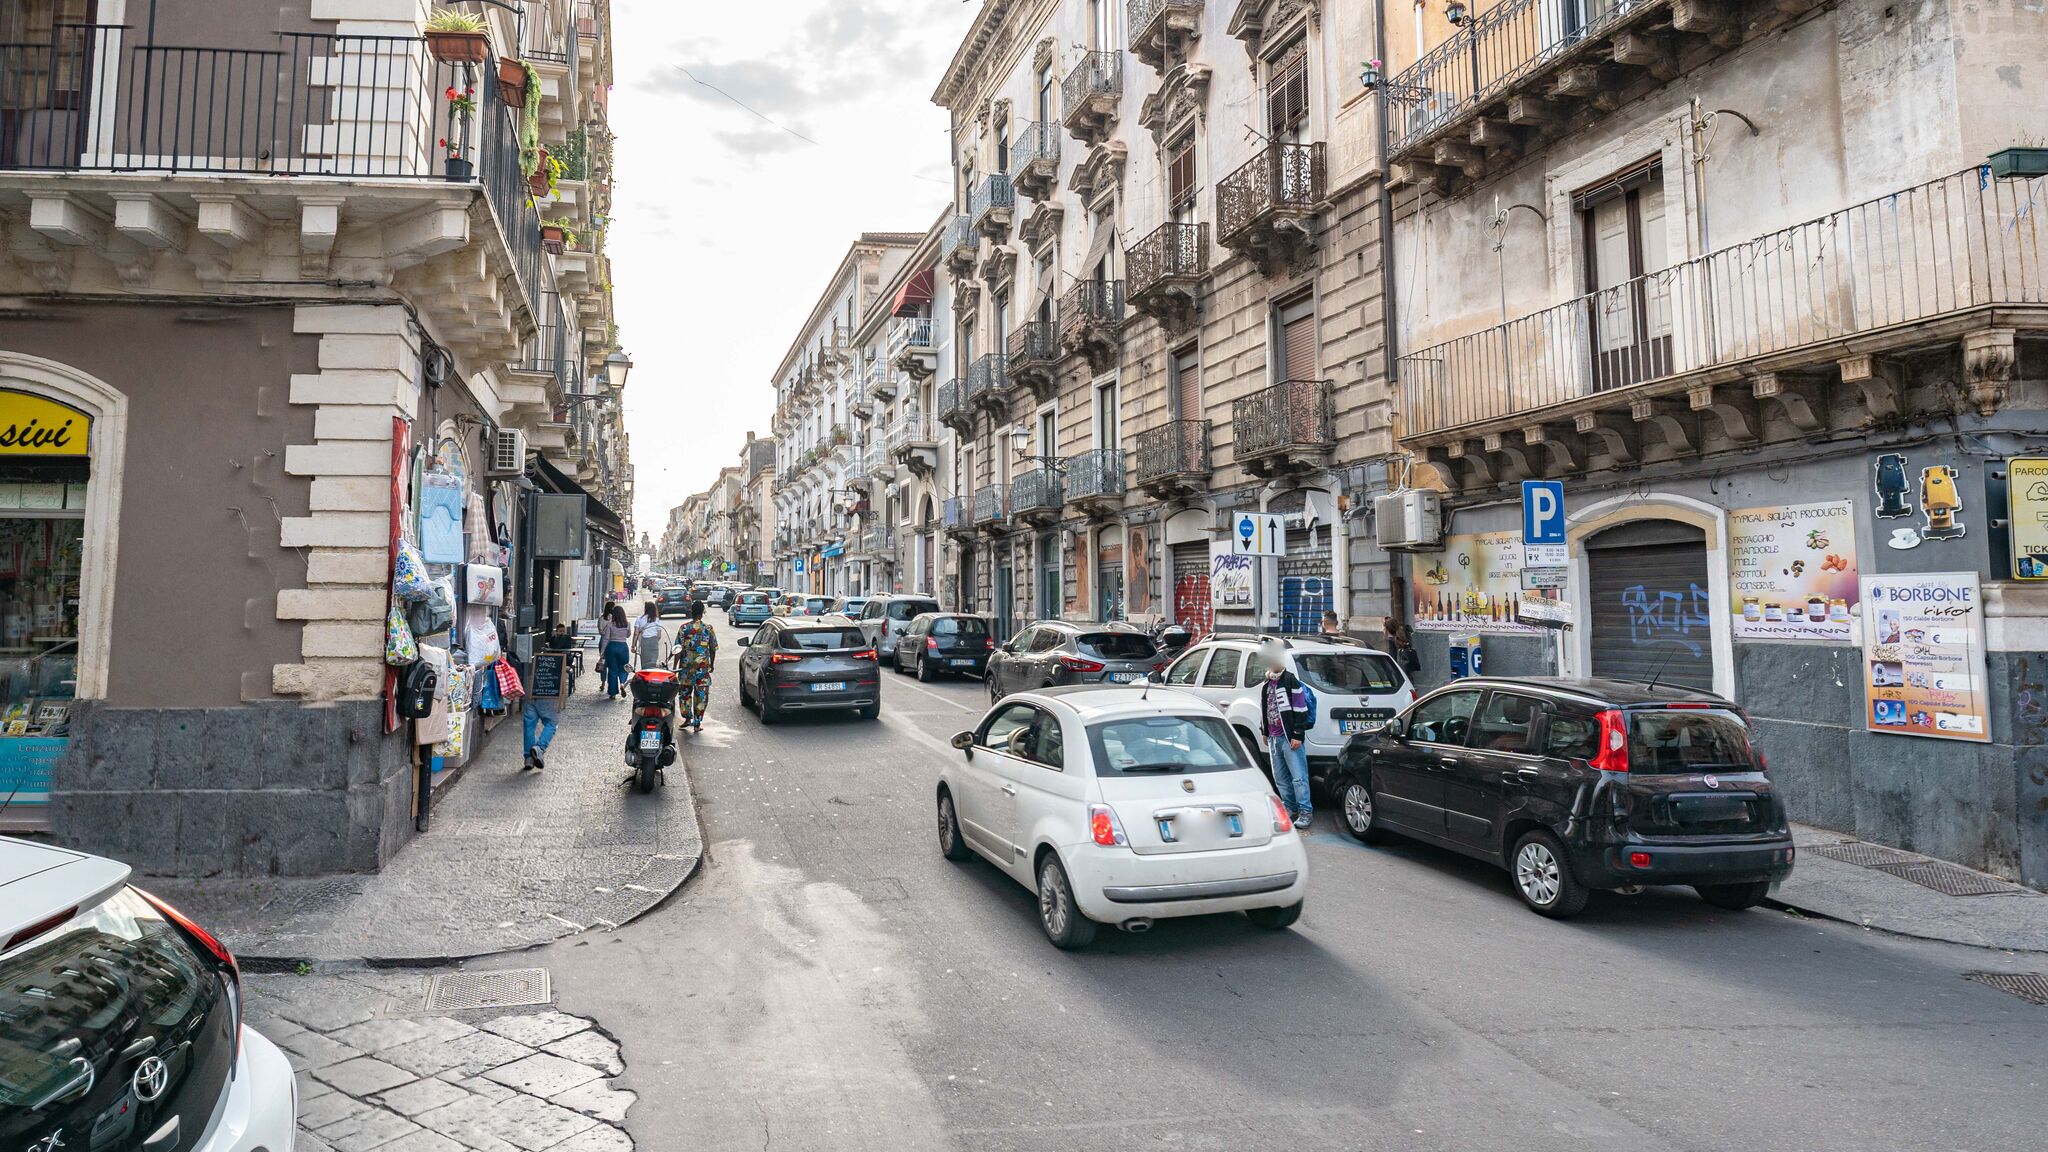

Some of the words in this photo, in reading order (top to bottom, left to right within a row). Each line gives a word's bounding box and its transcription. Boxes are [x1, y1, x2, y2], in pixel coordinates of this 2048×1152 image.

[1532, 488, 1557, 538] P
[1732, 514, 1765, 524] TYPICAL
[1800, 507, 1848, 519] PRODUCTS
[1734, 545, 1780, 555] MANDORLE
[796, 560, 803, 570] P
[1734, 558, 1757, 566] MIELE
[1736, 581, 1775, 590] CONSERVE
[1890, 587, 1971, 601] BORBONE
[1933, 634, 1941, 643] €
[1474, 654, 1482, 668] P
[1935, 680, 1944, 690] €
[1938, 720, 1947, 730] €
